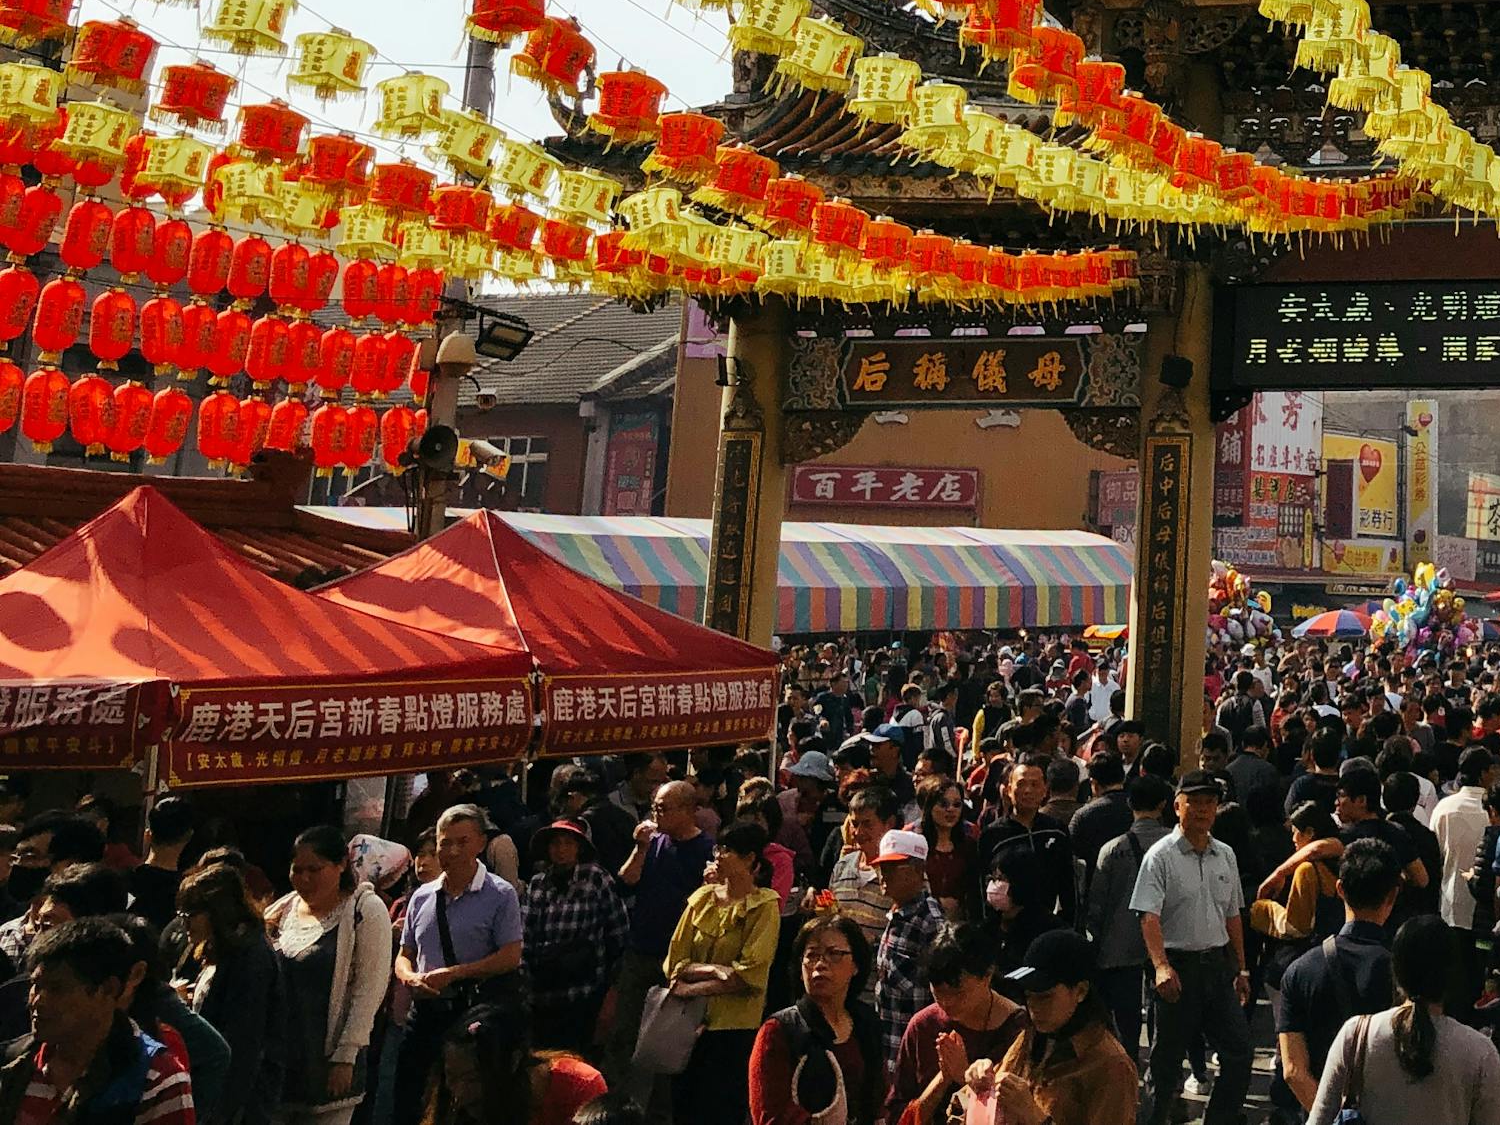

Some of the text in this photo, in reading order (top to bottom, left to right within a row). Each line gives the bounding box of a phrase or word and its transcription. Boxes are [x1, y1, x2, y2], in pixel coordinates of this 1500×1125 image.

[809, 472, 962, 502] 百年老店
[1414, 441, 1427, 502] 公益彩券
[1359, 508, 1394, 530] 彩券行
[181, 689, 527, 742] 鹿港天后宮新春點燈服務處
[552, 679, 772, 722] 鹿港天后宮新春點燈服務處
